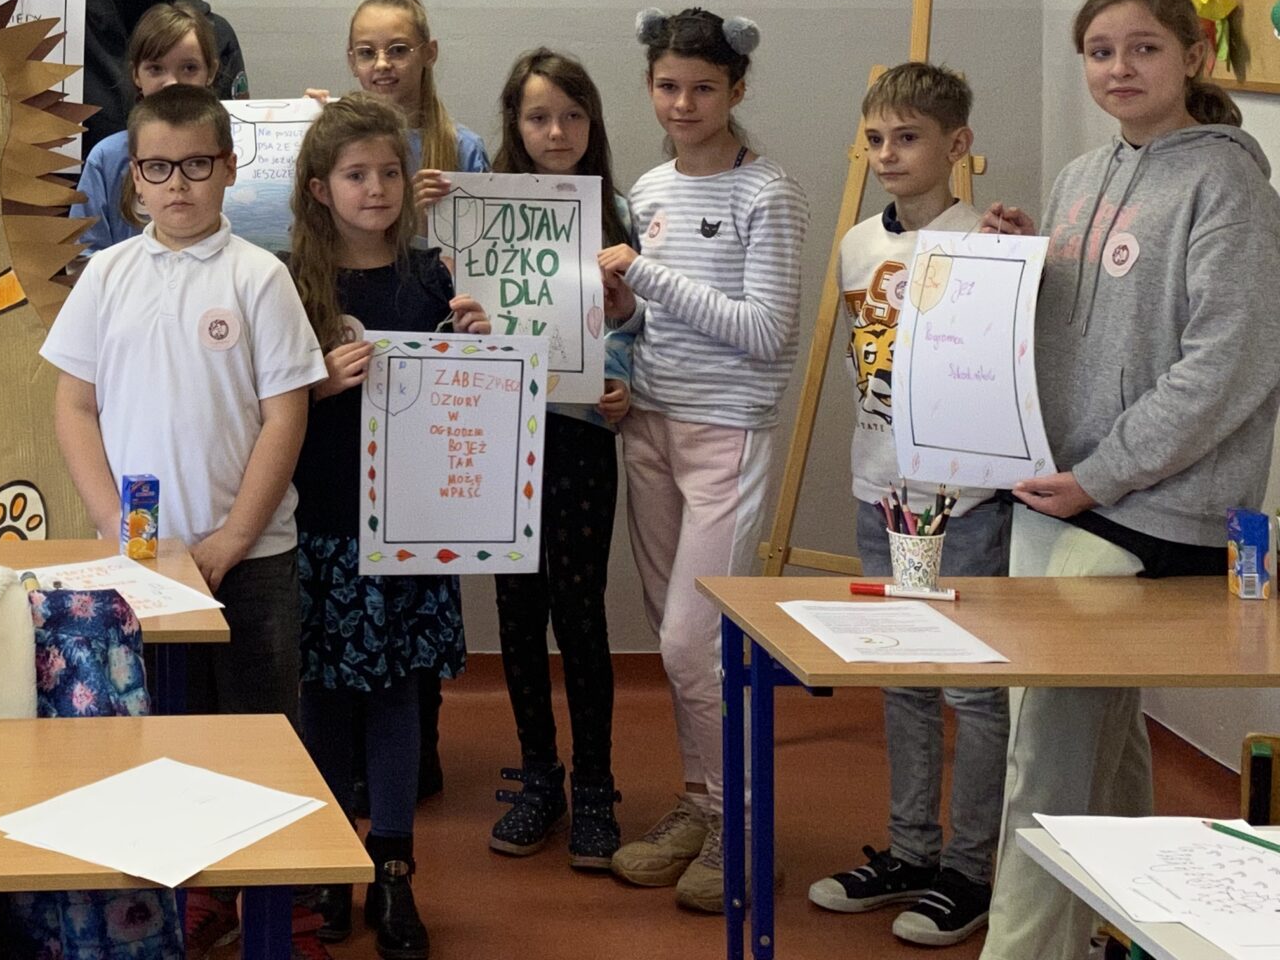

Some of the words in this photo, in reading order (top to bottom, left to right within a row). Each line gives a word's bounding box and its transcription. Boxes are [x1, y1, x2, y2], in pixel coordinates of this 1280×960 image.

[482, 202, 577, 244] ZOSTAW
[465, 240, 560, 278] ŁÓŻKO
[499, 277, 554, 309] DLA
[447, 410, 460, 422] W
[447, 454, 475, 469] TAM
